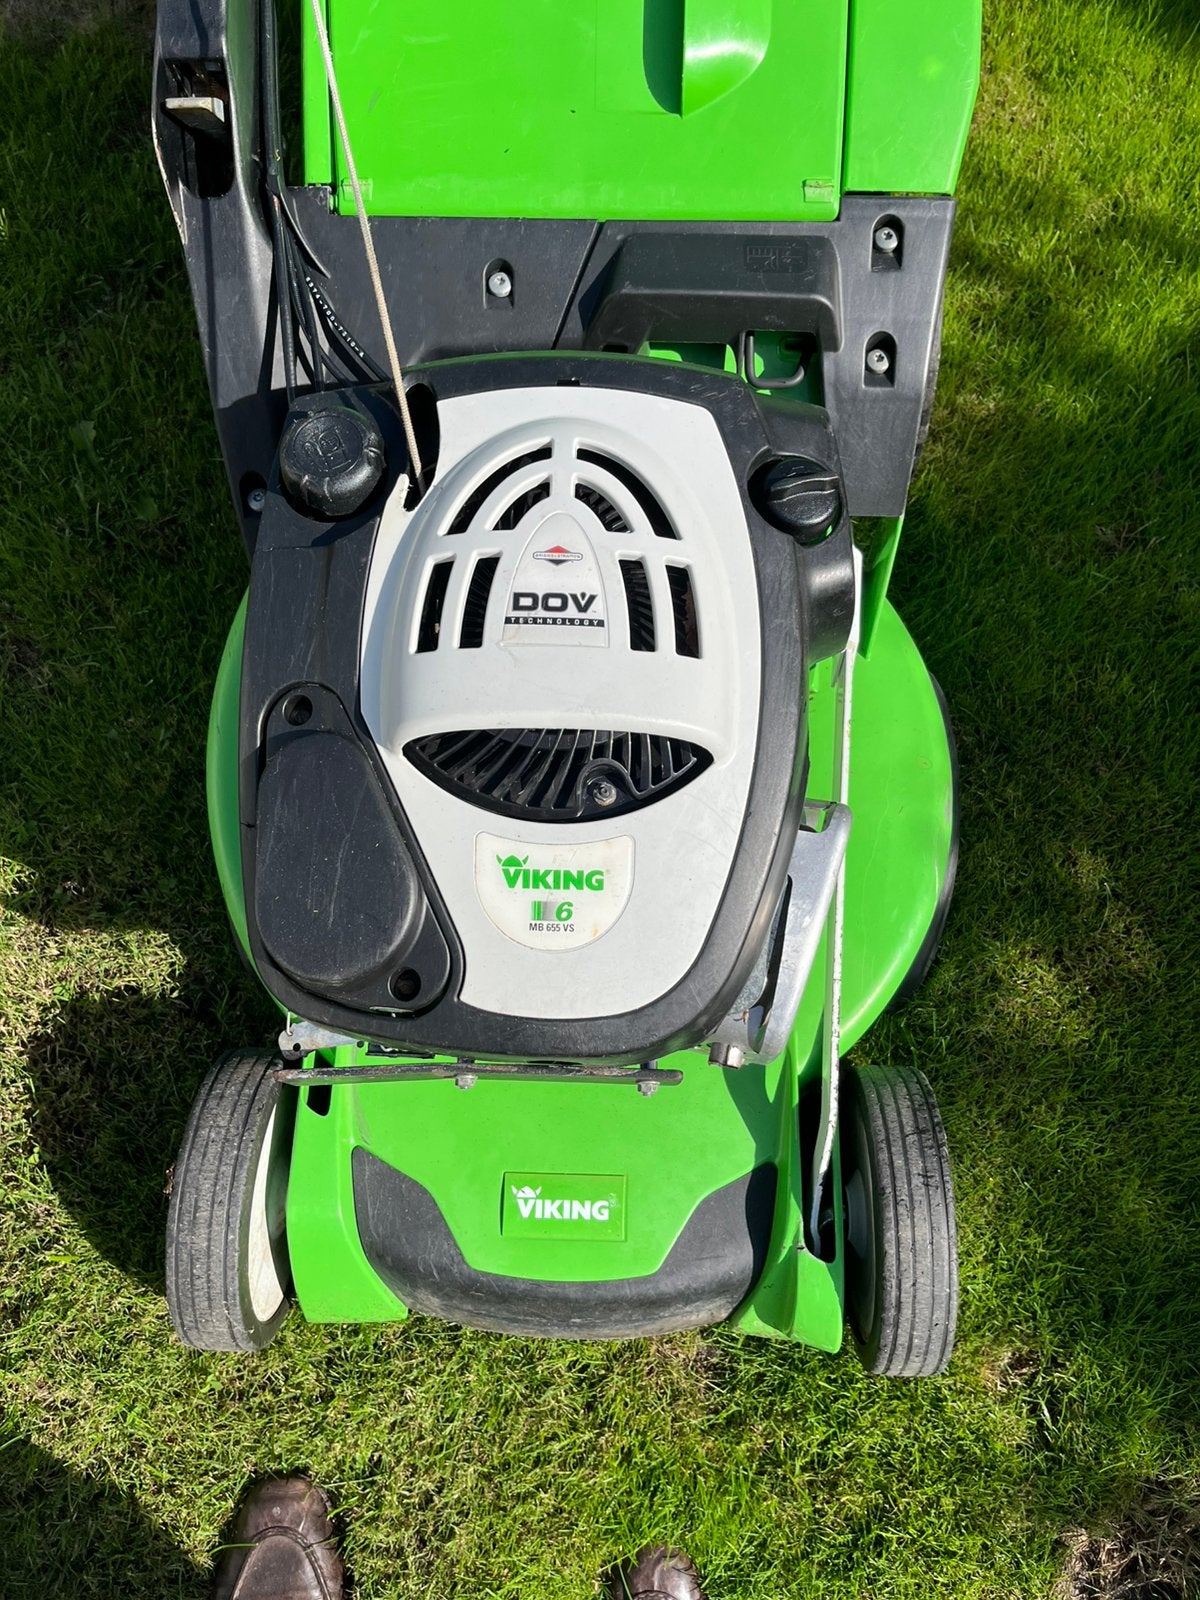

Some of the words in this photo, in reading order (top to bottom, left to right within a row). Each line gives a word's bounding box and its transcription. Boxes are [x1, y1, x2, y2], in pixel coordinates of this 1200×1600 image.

[512, 592, 598, 613] DOV
[510, 617, 599, 626] TECHNOLOGY
[501, 868, 604, 891] VIKING
[555, 901, 574, 922] 6
[529, 922, 544, 932] MB
[546, 923, 561, 932] 655
[562, 923, 575, 932] VS
[516, 1199, 609, 1221] VIKING
